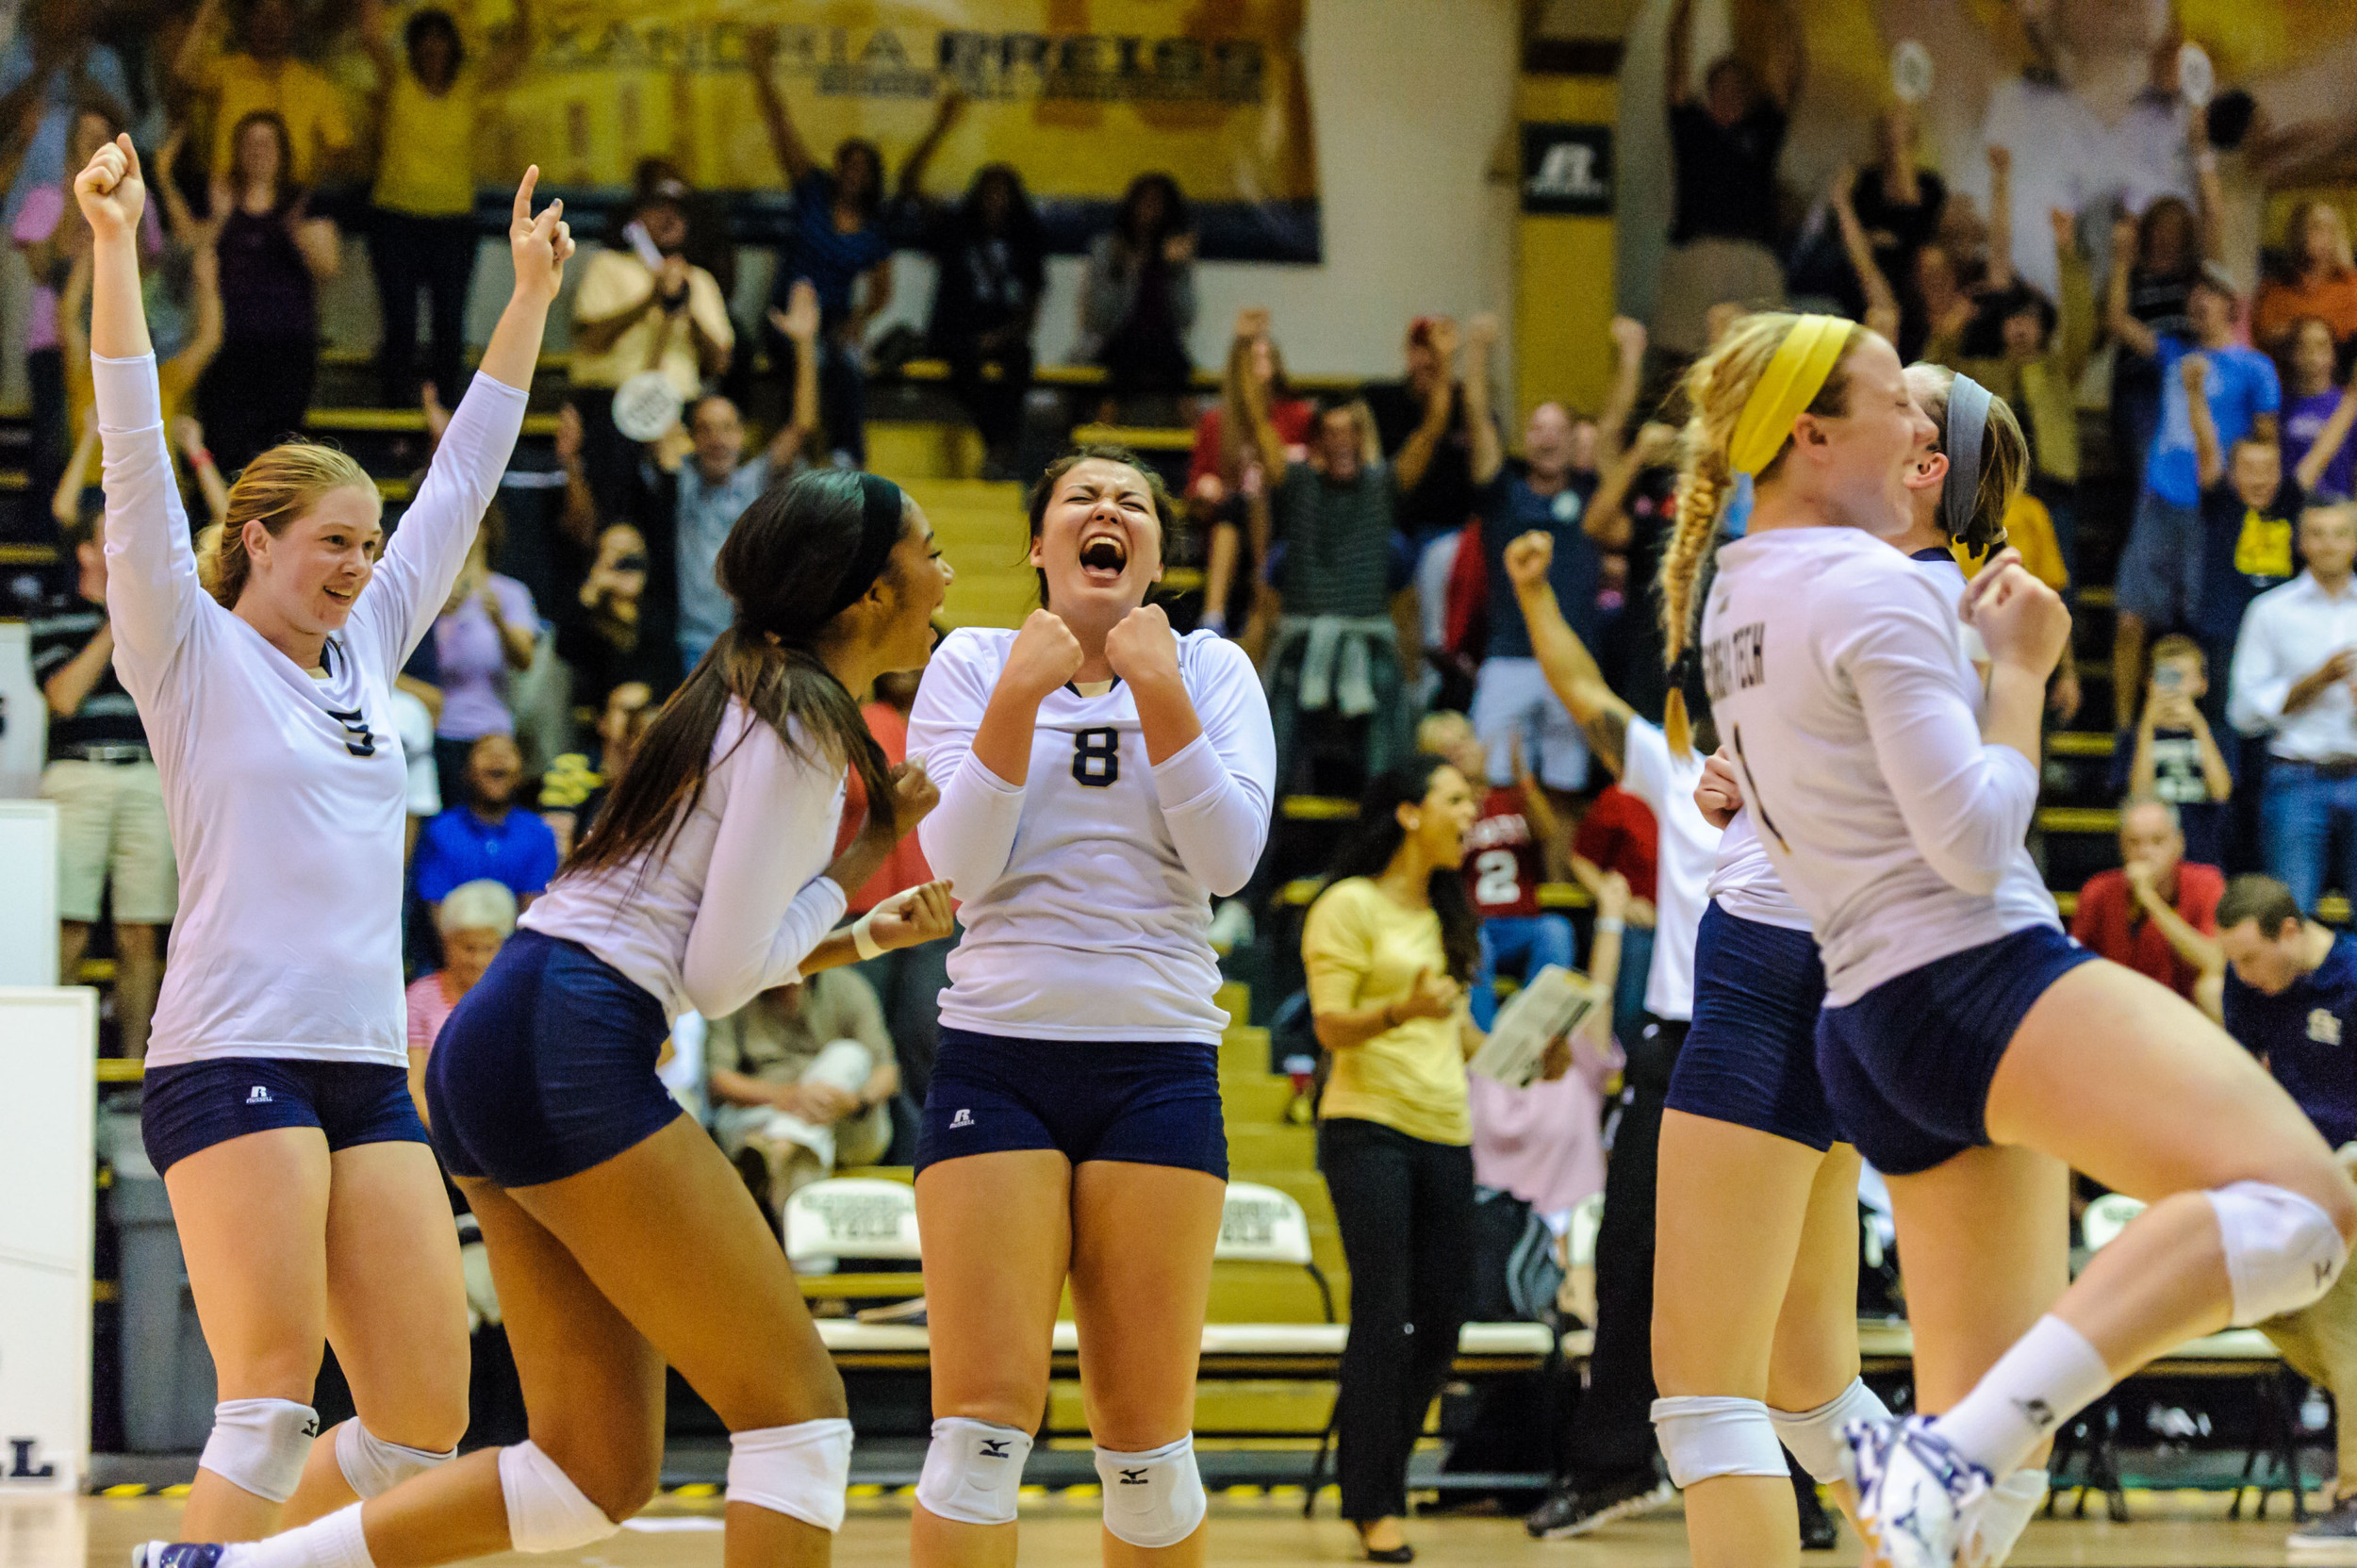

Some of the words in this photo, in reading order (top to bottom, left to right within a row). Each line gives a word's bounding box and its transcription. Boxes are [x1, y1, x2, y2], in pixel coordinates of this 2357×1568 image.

[1070, 726, 1121, 789] 8
[1475, 850, 1521, 904] 2
[8, 1440, 55, 1477] L
